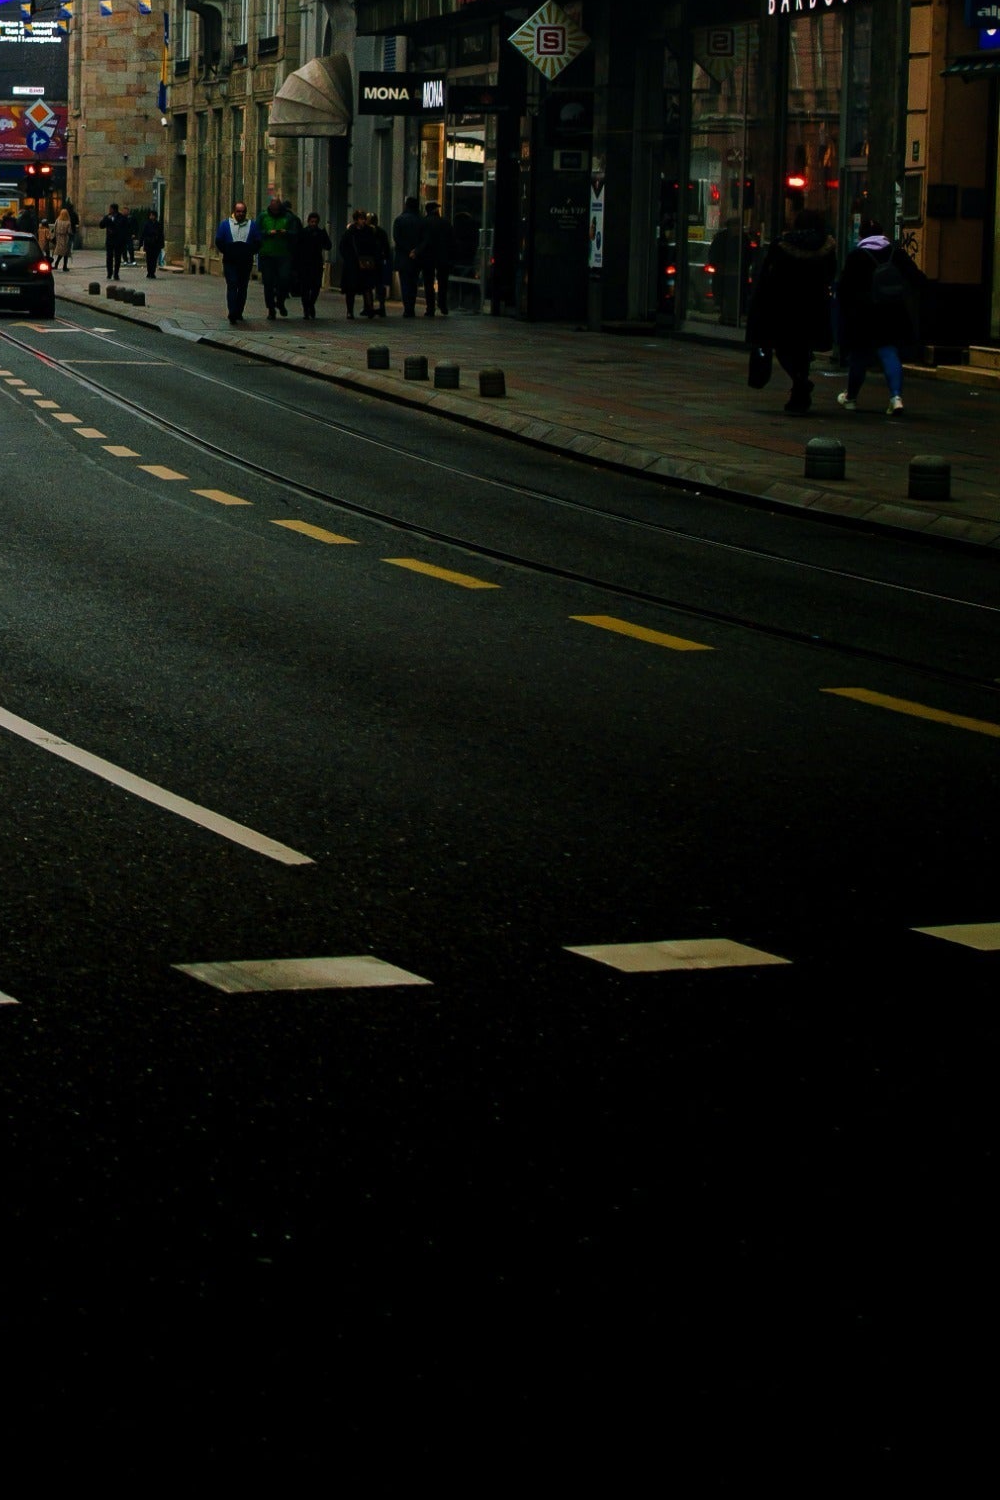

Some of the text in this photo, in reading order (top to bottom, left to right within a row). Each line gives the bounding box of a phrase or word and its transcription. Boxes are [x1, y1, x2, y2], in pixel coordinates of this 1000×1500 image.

[543, 32, 560, 49] S
[364, 87, 410, 100] MONA
[422, 80, 444, 108] MONA
